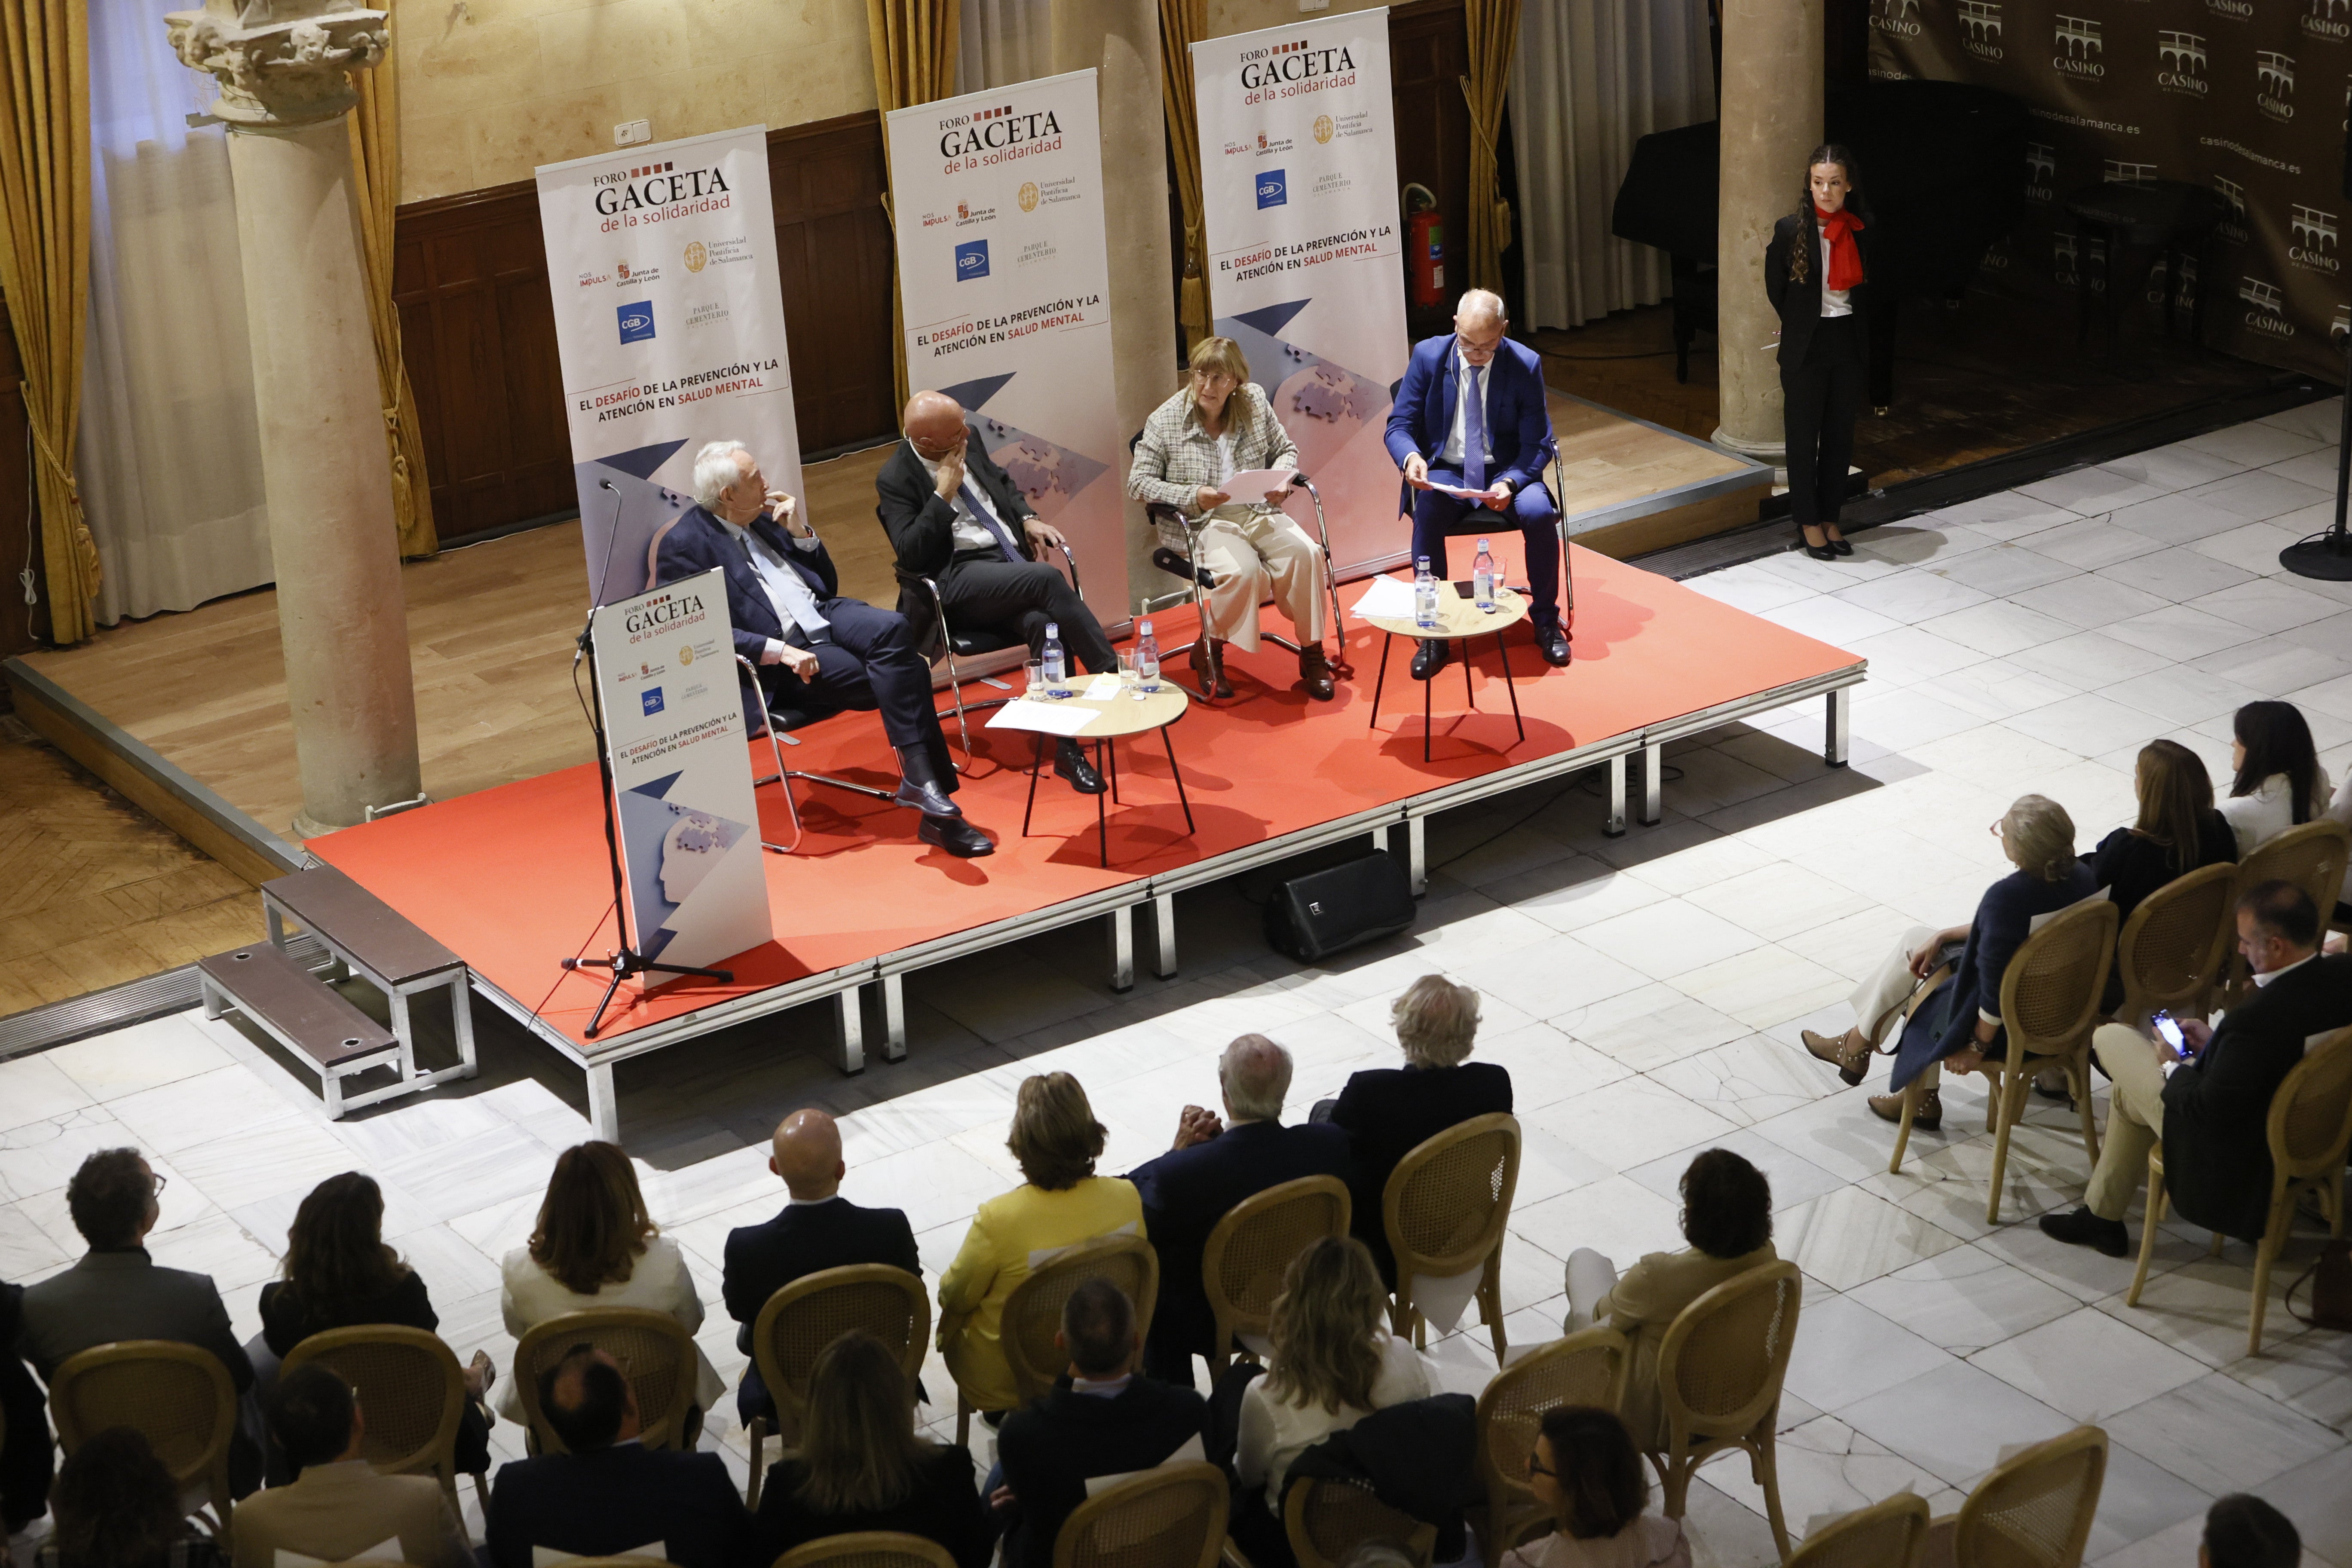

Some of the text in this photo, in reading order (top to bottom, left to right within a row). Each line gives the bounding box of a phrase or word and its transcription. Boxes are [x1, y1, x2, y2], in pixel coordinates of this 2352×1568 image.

[2206, 0, 2253, 16] CASINO
[1869, 15, 1920, 35] CASINO
[2301, 14, 2350, 37] CASINO
[1240, 49, 1268, 62] FORO
[1963, 38, 2003, 59] CASINO
[1241, 46, 1356, 89] GACETA
[2053, 57, 2104, 77] CASINO
[1245, 71, 1355, 105] de la solidaridad
[2158, 72, 2208, 94] CASINO
[2257, 93, 2294, 118] CASINO
[940, 115, 970, 130] FORO
[1335, 110, 1368, 122] Universidad
[1336, 120, 1362, 130] Pontificia
[940, 110, 1062, 158] GACETA
[1344, 128, 1373, 136] Salamanca
[944, 136, 1061, 175] de la solidaridad
[1256, 148, 1273, 156] Castilla
[2200, 137, 2301, 175] casinodesalamanca.es
[593, 171, 627, 187] FORO
[1040, 176, 1075, 189] Universidad
[1313, 180, 1351, 193] CEMENTERIO
[1319, 172, 1342, 183] PARQUE
[595, 167, 730, 215] GACETA
[1041, 187, 1068, 197] Pontificia
[1048, 194, 1081, 203] Salamanca
[1258, 185, 1274, 196] CGB
[601, 194, 730, 233] de la solidaridad
[956, 218, 975, 227] Castilla
[2215, 222, 2248, 242] ASINO
[708, 236, 747, 249] Universidad
[1024, 241, 1047, 252] PARQUE
[1221, 226, 1391, 271] EL DESAFÍO DE LA PREVENCIÓN Y LA
[709, 248, 739, 257] Pontificia
[718, 254, 753, 264] Salamanca
[1017, 248, 1056, 263] CEMENTERIO
[2288, 246, 2340, 271] CASINO
[958, 256, 977, 268] CGB
[1236, 243, 1377, 282] ATENCIÓN EN SALUD MENTAL
[616, 279, 637, 287] Castilla
[686, 310, 729, 325] CEMENTERIO
[693, 303, 719, 315] PARQUE
[620, 318, 640, 330] CGB
[918, 294, 1099, 346] EL DESAFÍO DE LA PREVENCIÓN Y LA
[2245, 312, 2294, 336] CASINO
[934, 312, 1084, 357] ATENCIÓN EN SALUD MENTAL
[580, 359, 778, 411] EL DESAFÍO DE LA PREVENCIÓN Y LA
[599, 377, 763, 423] ATENCIÓN EN SALUD MENTAL
[625, 603, 644, 616] FORO
[626, 595, 704, 633] GACETA
[629, 611, 705, 644] de la solidaridad
[630, 740, 658, 756] DESAFÍO
[659, 736, 668, 745] DE
[669, 733, 678, 741] LA
[679, 717, 721, 738] PREVENCIÓN
[728, 712, 737, 720] LA
[632, 726, 729, 765] ATENCIÓN EN SALUD MENTAL
